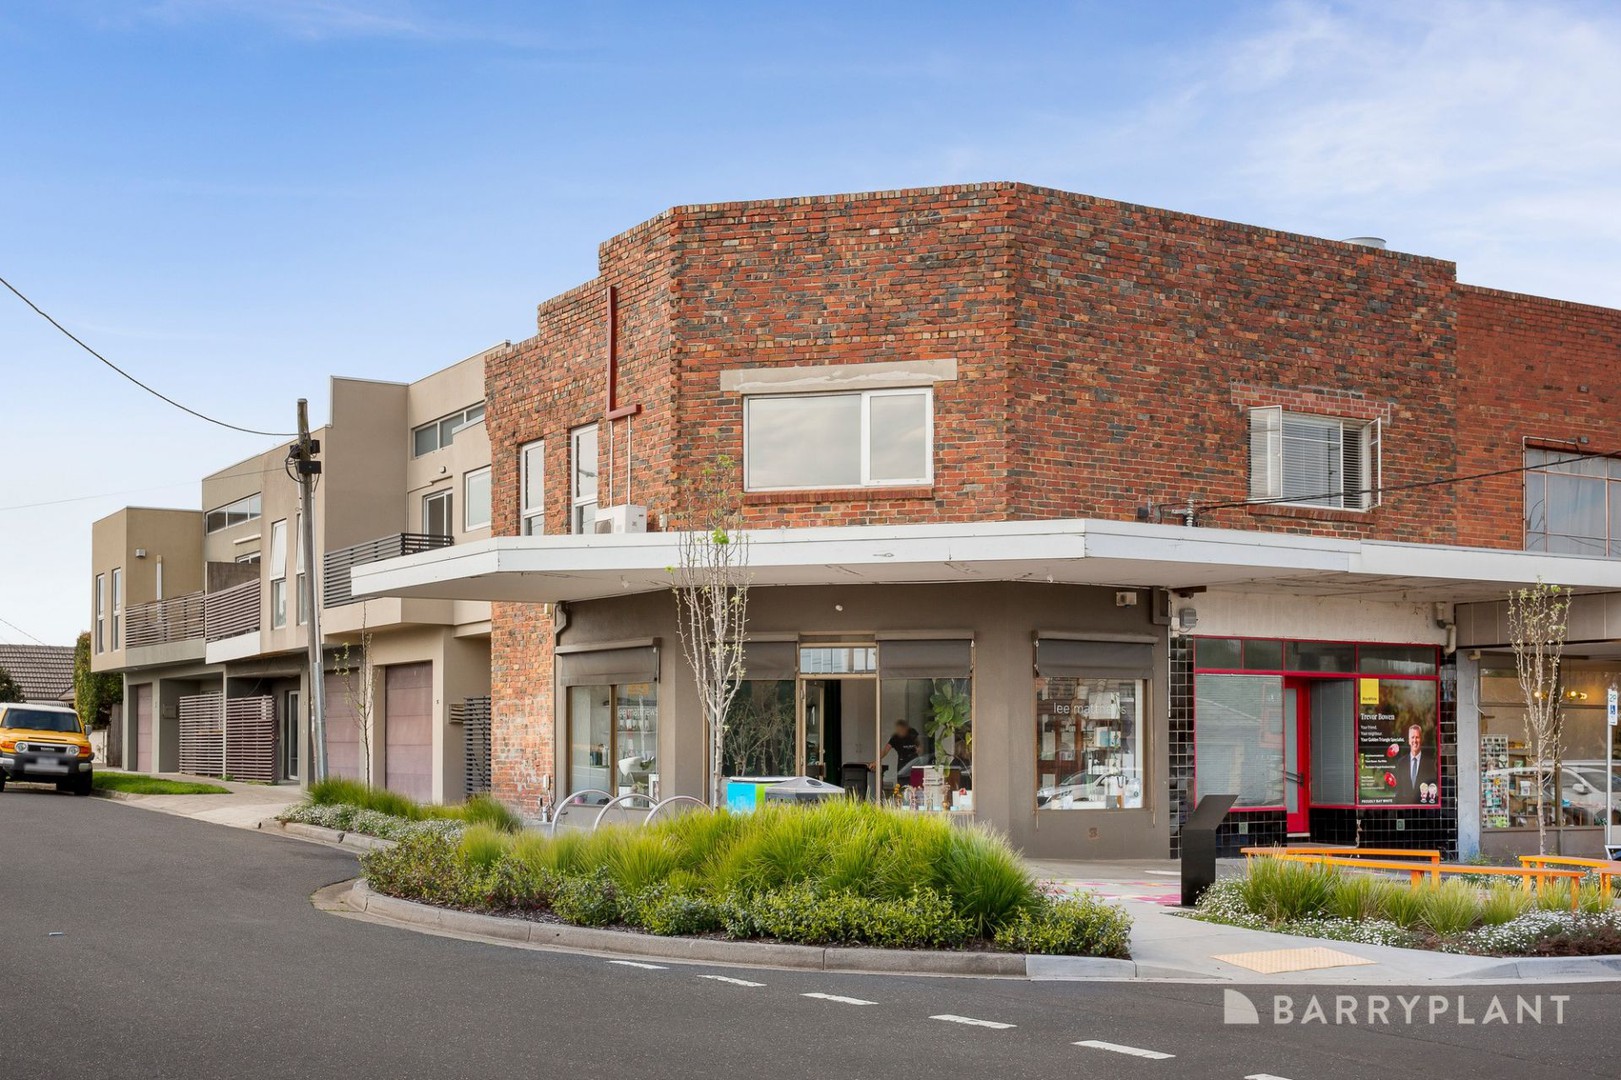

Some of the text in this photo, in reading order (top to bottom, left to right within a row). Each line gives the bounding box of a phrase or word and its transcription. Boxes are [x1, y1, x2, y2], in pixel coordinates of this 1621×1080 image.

[1053, 702, 1127, 715] lee matthes
[1378, 713, 1395, 721] Bowen
